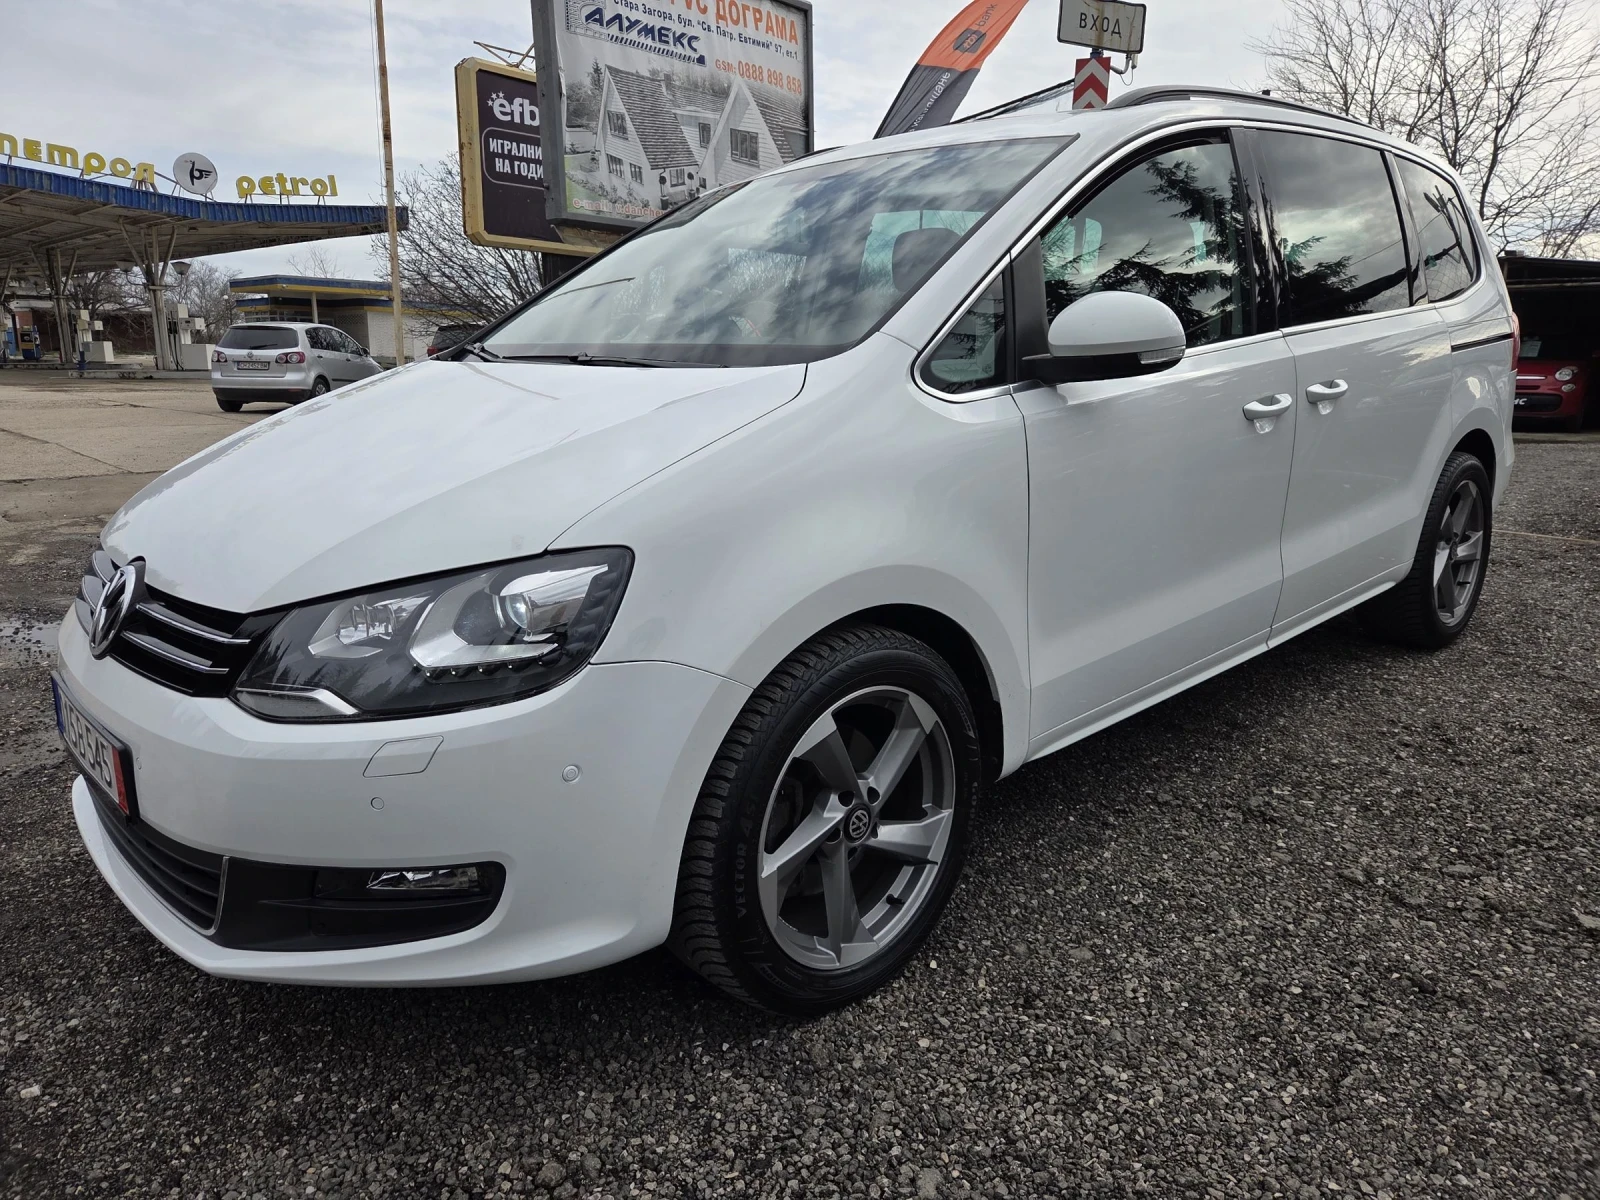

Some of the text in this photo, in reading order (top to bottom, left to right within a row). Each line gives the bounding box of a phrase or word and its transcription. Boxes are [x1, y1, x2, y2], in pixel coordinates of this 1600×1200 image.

[641, 3, 676, 24] Загора,
[677, 13, 696, 28] бул.
[715, 0, 799, 46] ДОГРАМА
[975, 3, 998, 27] bank
[1079, 12, 1122, 38] ВХОД
[584, 7, 701, 53] АЛУМЕКС
[715, 58, 803, 96] GSM: 0888 898 858
[493, 97, 541, 127] efb
[0, 132, 155, 184] петрол
[489, 137, 543, 161] ИГРАЛНИ
[495, 157, 545, 181] НА ГОДИ
[236, 172, 339, 199] petrol
